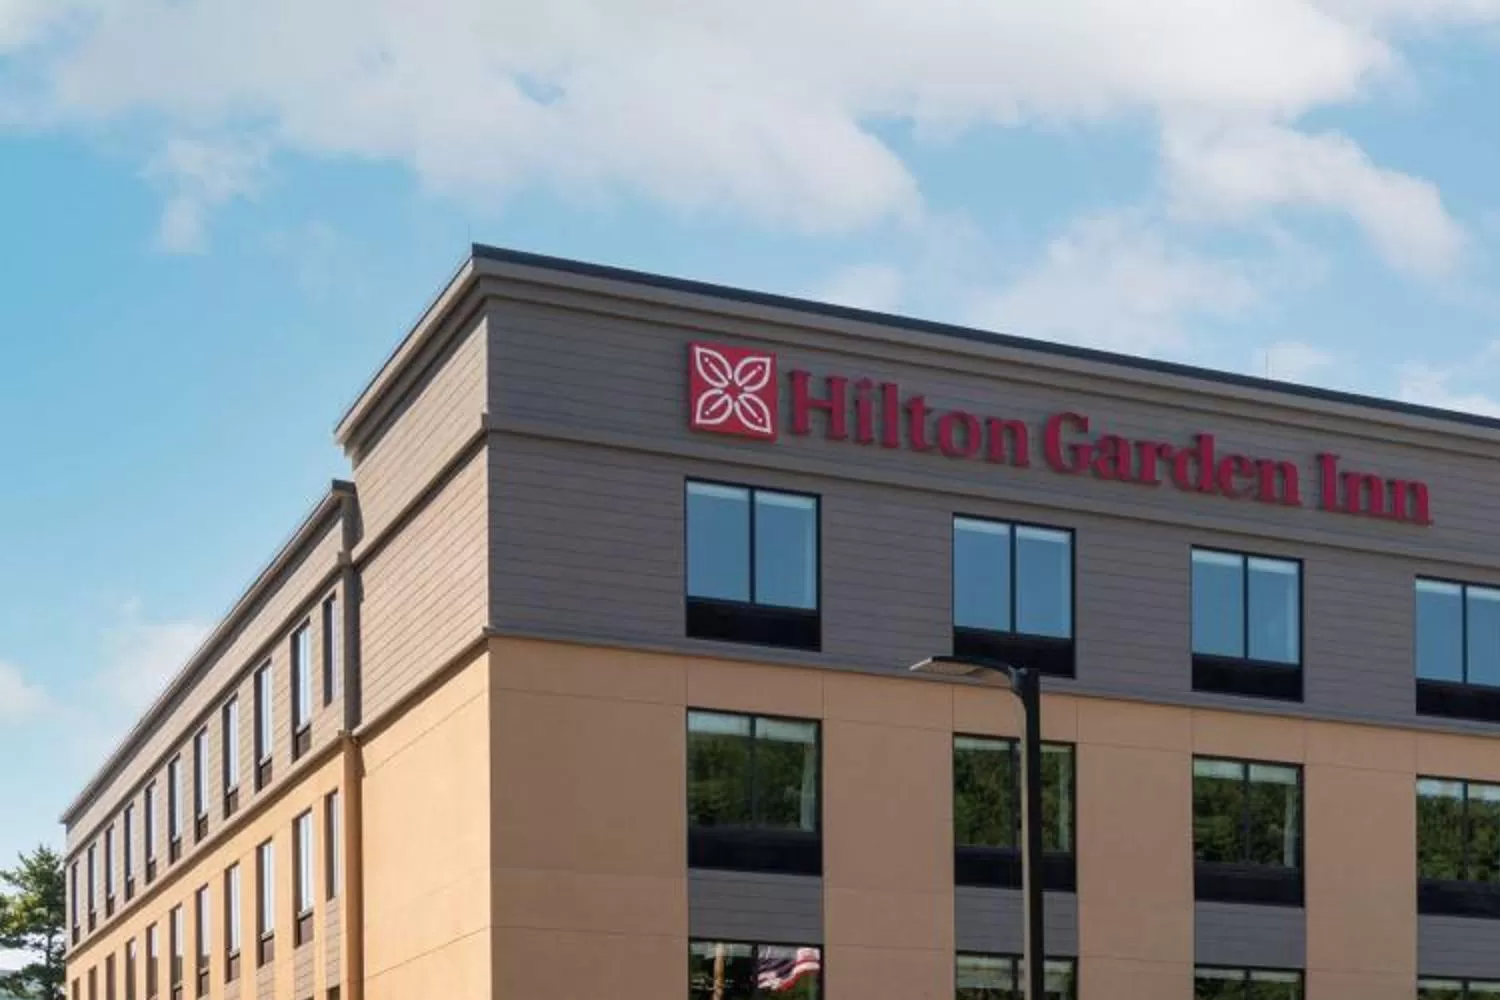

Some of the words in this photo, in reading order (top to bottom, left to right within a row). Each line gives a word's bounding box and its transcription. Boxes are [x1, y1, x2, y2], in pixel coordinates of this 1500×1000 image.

[788, 369, 1030, 467] Hilton
[1043, 411, 1303, 507] Garden
[1316, 451, 1434, 527] Inn
